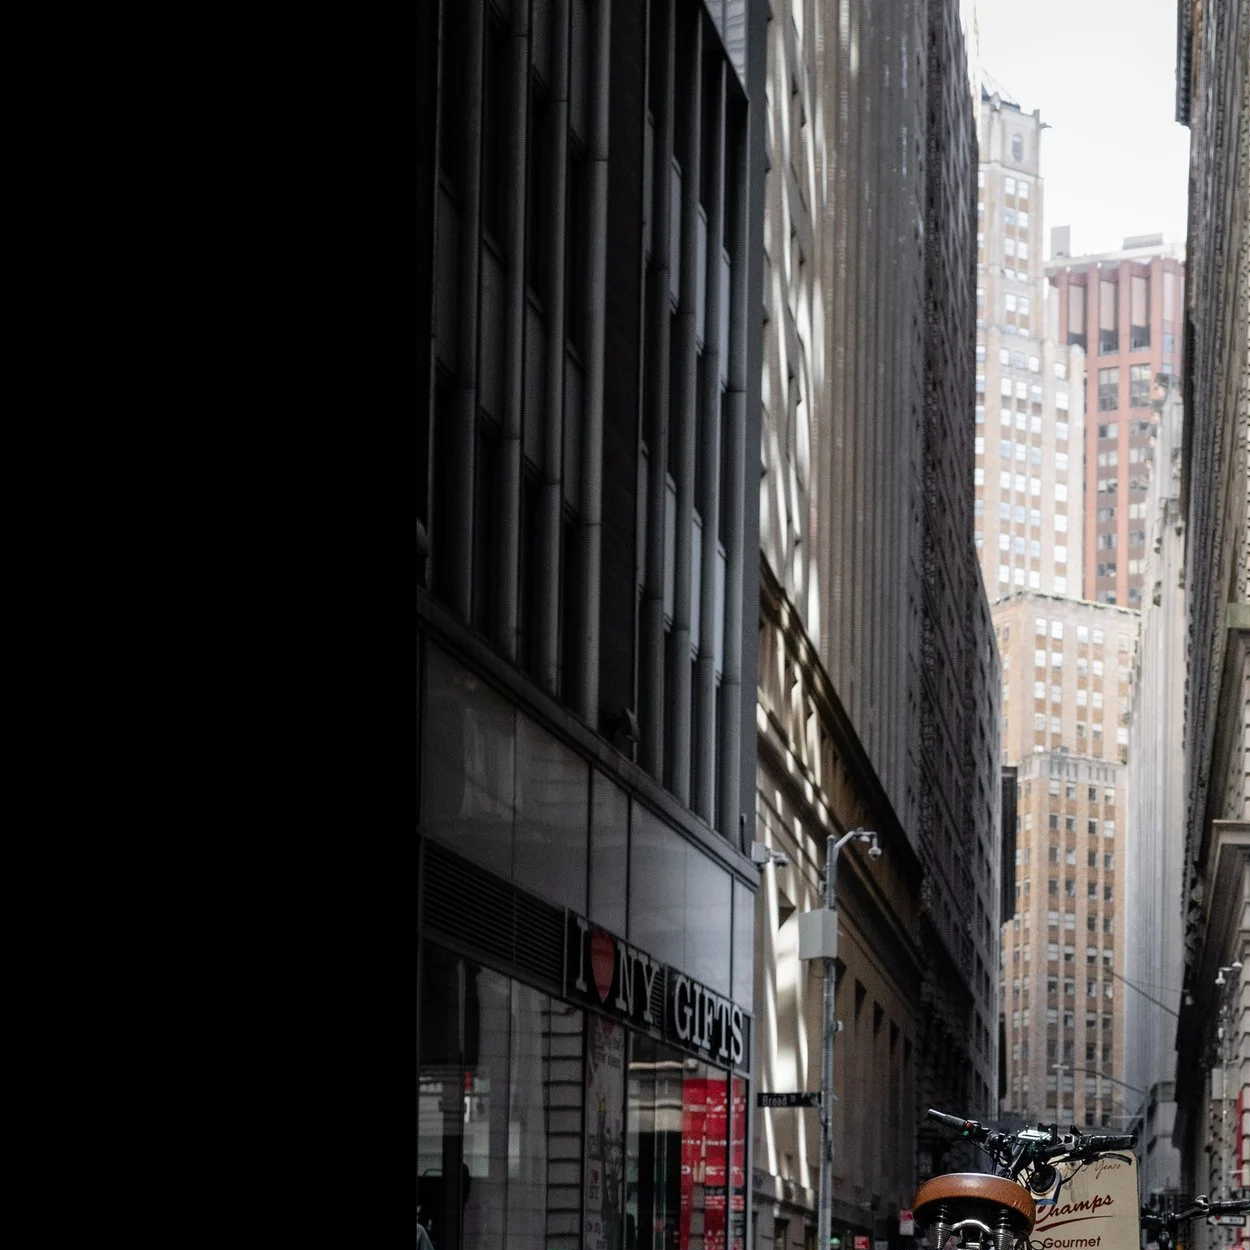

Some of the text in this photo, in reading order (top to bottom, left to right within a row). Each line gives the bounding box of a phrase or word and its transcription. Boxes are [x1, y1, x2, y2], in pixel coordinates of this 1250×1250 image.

[615, 940, 660, 1025] NY
[674, 974, 743, 1064] GIFTS
[1043, 1236, 1102, 1249] Gourmet
